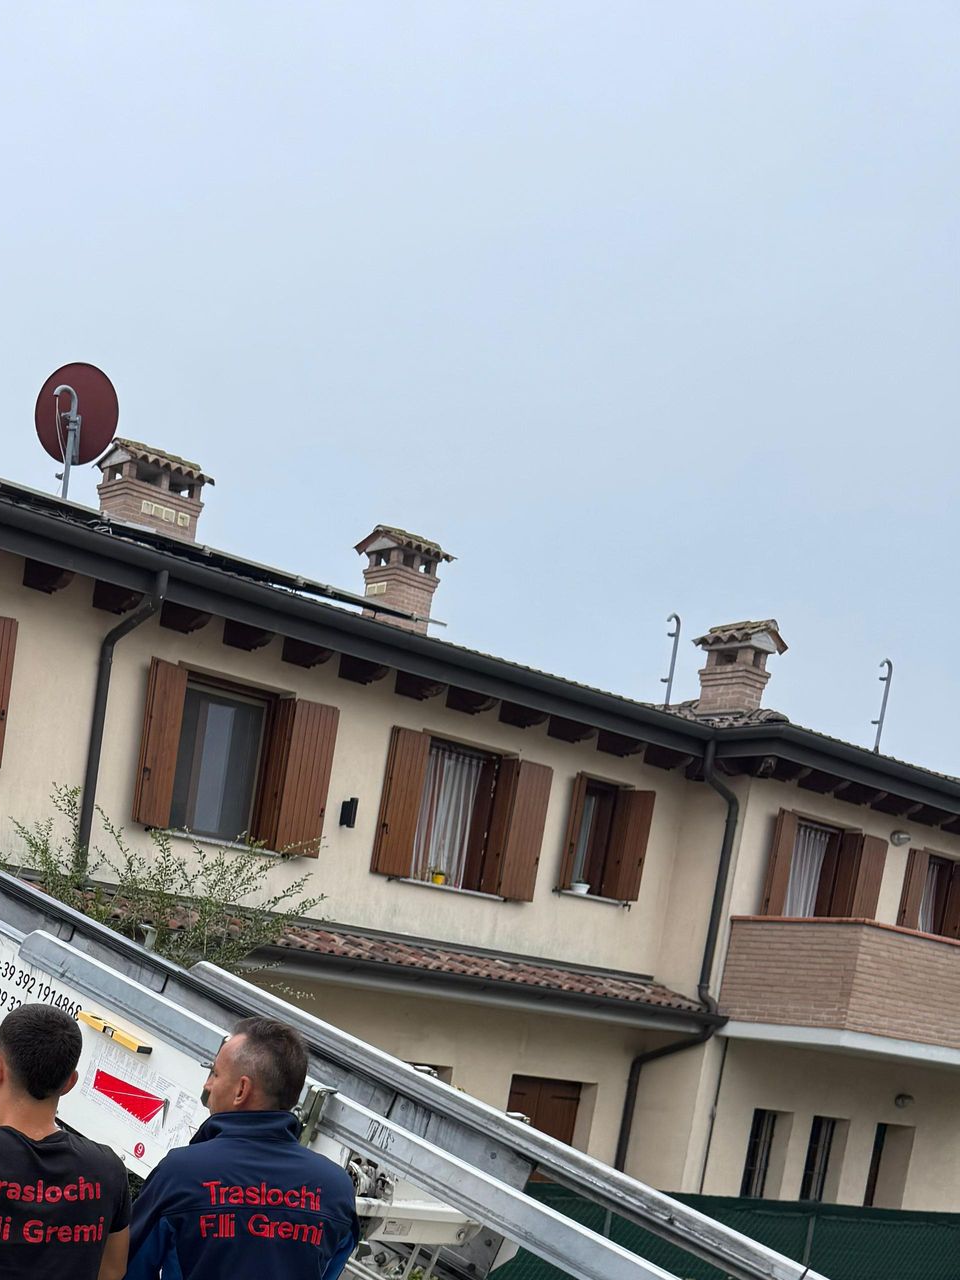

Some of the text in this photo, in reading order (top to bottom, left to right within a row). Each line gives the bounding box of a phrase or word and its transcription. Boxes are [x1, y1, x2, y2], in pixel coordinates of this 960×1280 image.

[15, 970, 36, 994] 392
[202, 1180, 322, 1212] Traslochi
[22, 1216, 105, 1244] Gremi
[199, 1213, 324, 1246] F.lli Gremi
